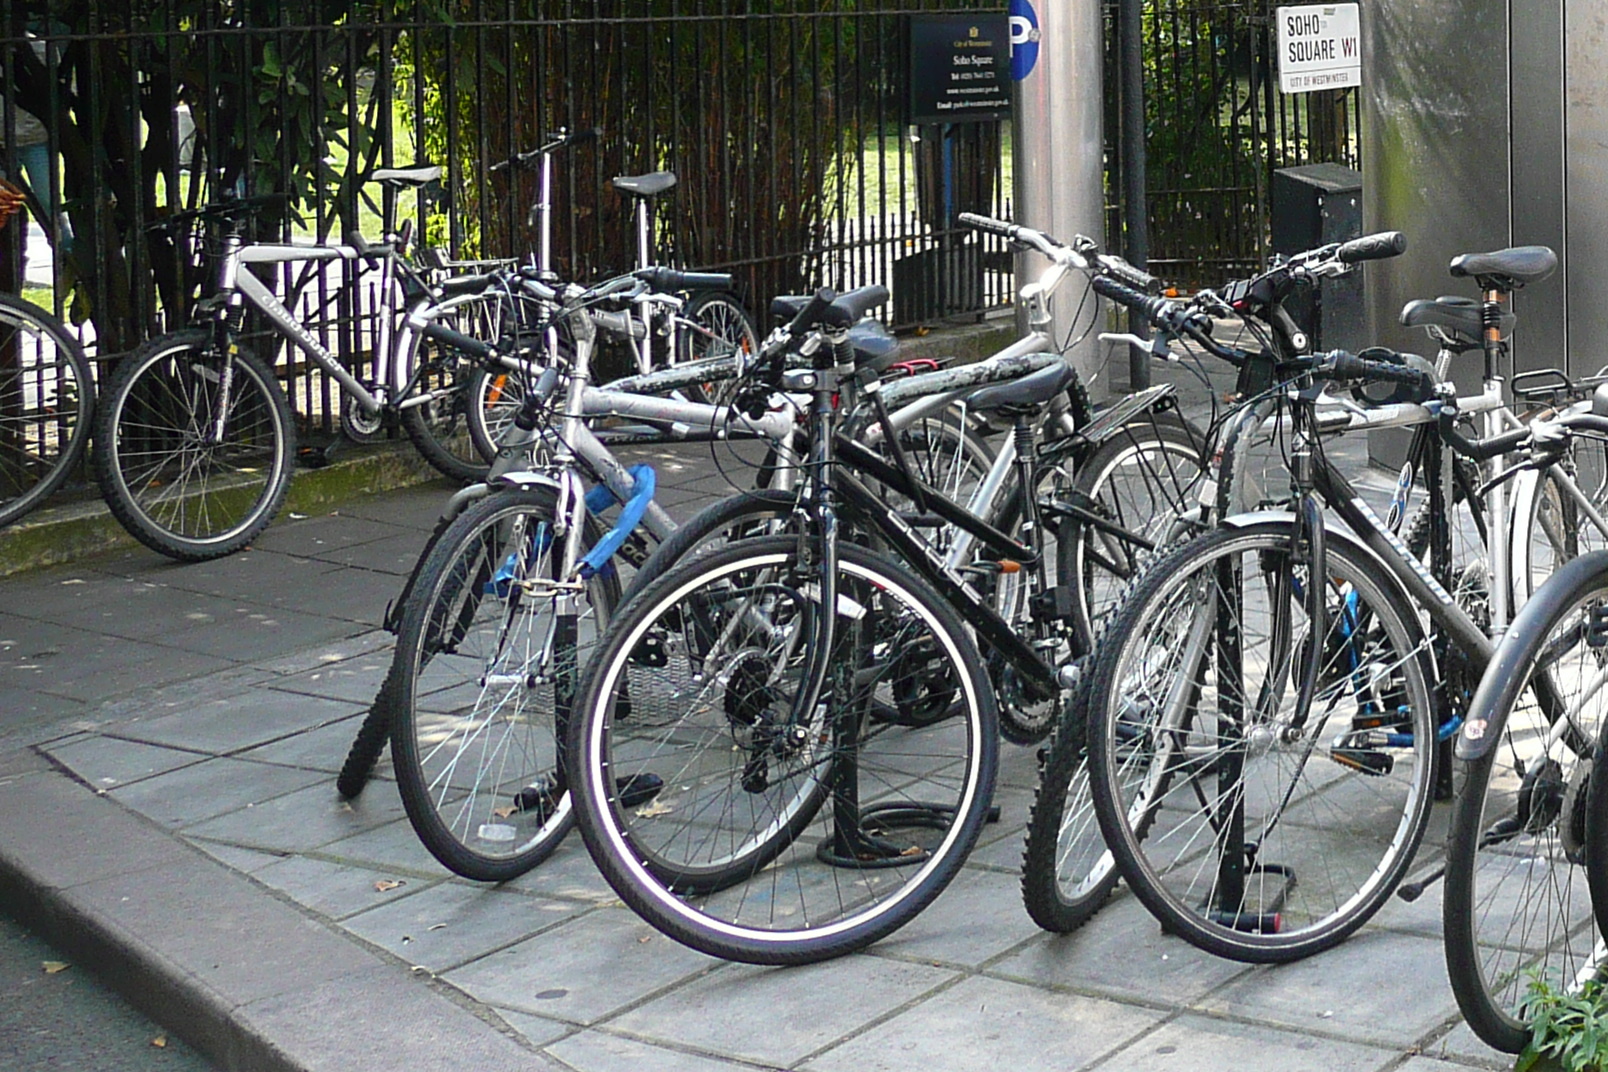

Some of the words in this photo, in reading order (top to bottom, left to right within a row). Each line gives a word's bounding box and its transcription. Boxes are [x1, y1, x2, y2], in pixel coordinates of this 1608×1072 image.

[1287, 14, 1320, 37] SOHO
[953, 55, 971, 66] Soho
[971, 54, 994, 67] Square
[1288, 39, 1336, 63] SQUARE
[1341, 36, 1357, 58] W1
[1290, 76, 1302, 87] CITY
[1303, 75, 1311, 86] OF
[1311, 73, 1349, 85] WESTMINSTER
[262, 295, 302, 332] claud
[300, 330, 342, 371] butler
